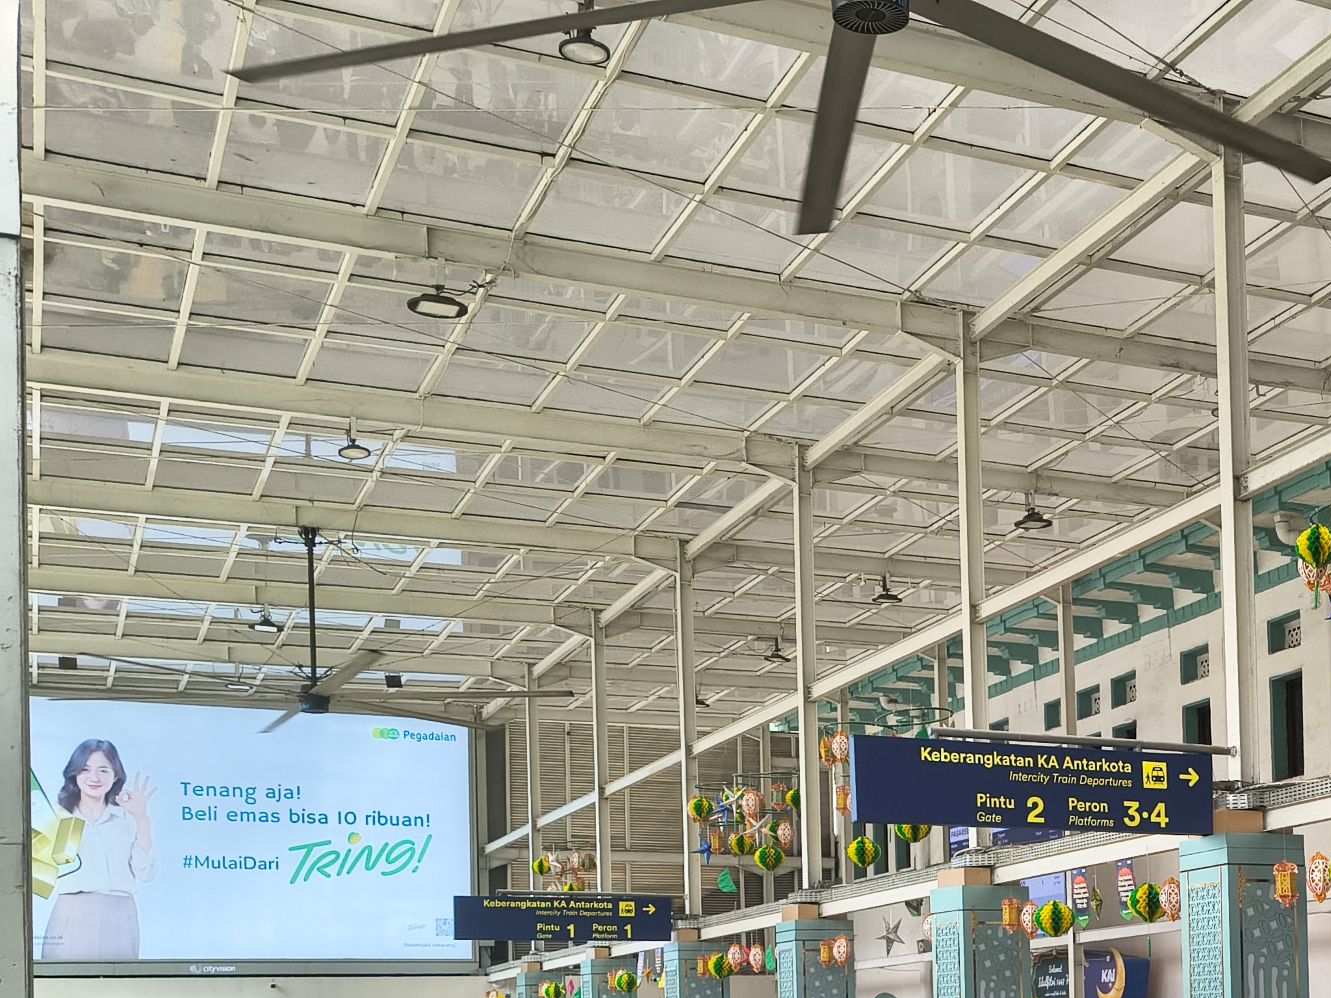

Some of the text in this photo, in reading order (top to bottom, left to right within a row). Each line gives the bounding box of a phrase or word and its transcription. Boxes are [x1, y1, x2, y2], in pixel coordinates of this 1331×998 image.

[403, 730, 457, 743] Pegadaian
[920, 746, 1132, 774] Keberangkatan KA Antarkota
[1009, 770, 1132, 789] Intercity Train Departures
[180, 782, 301, 805] Tenang aja!
[181, 806, 218, 821] Beli
[226, 809, 281, 823] emas
[289, 808, 329, 824] bisa
[365, 811, 432, 828] ribuan!
[977, 794, 1015, 810] Pintu
[1026, 796, 1045, 823] 2
[1068, 797, 1108, 814] Peron
[976, 811, 1115, 828] Gate Platforms
[183, 855, 280, 870] #MulaiDari
[483, 899, 613, 909] Keberangkatan KA Antarkota
[536, 923, 632, 938] Pintu 1 Peron 1
[1101, 968, 1116, 983] KAI
